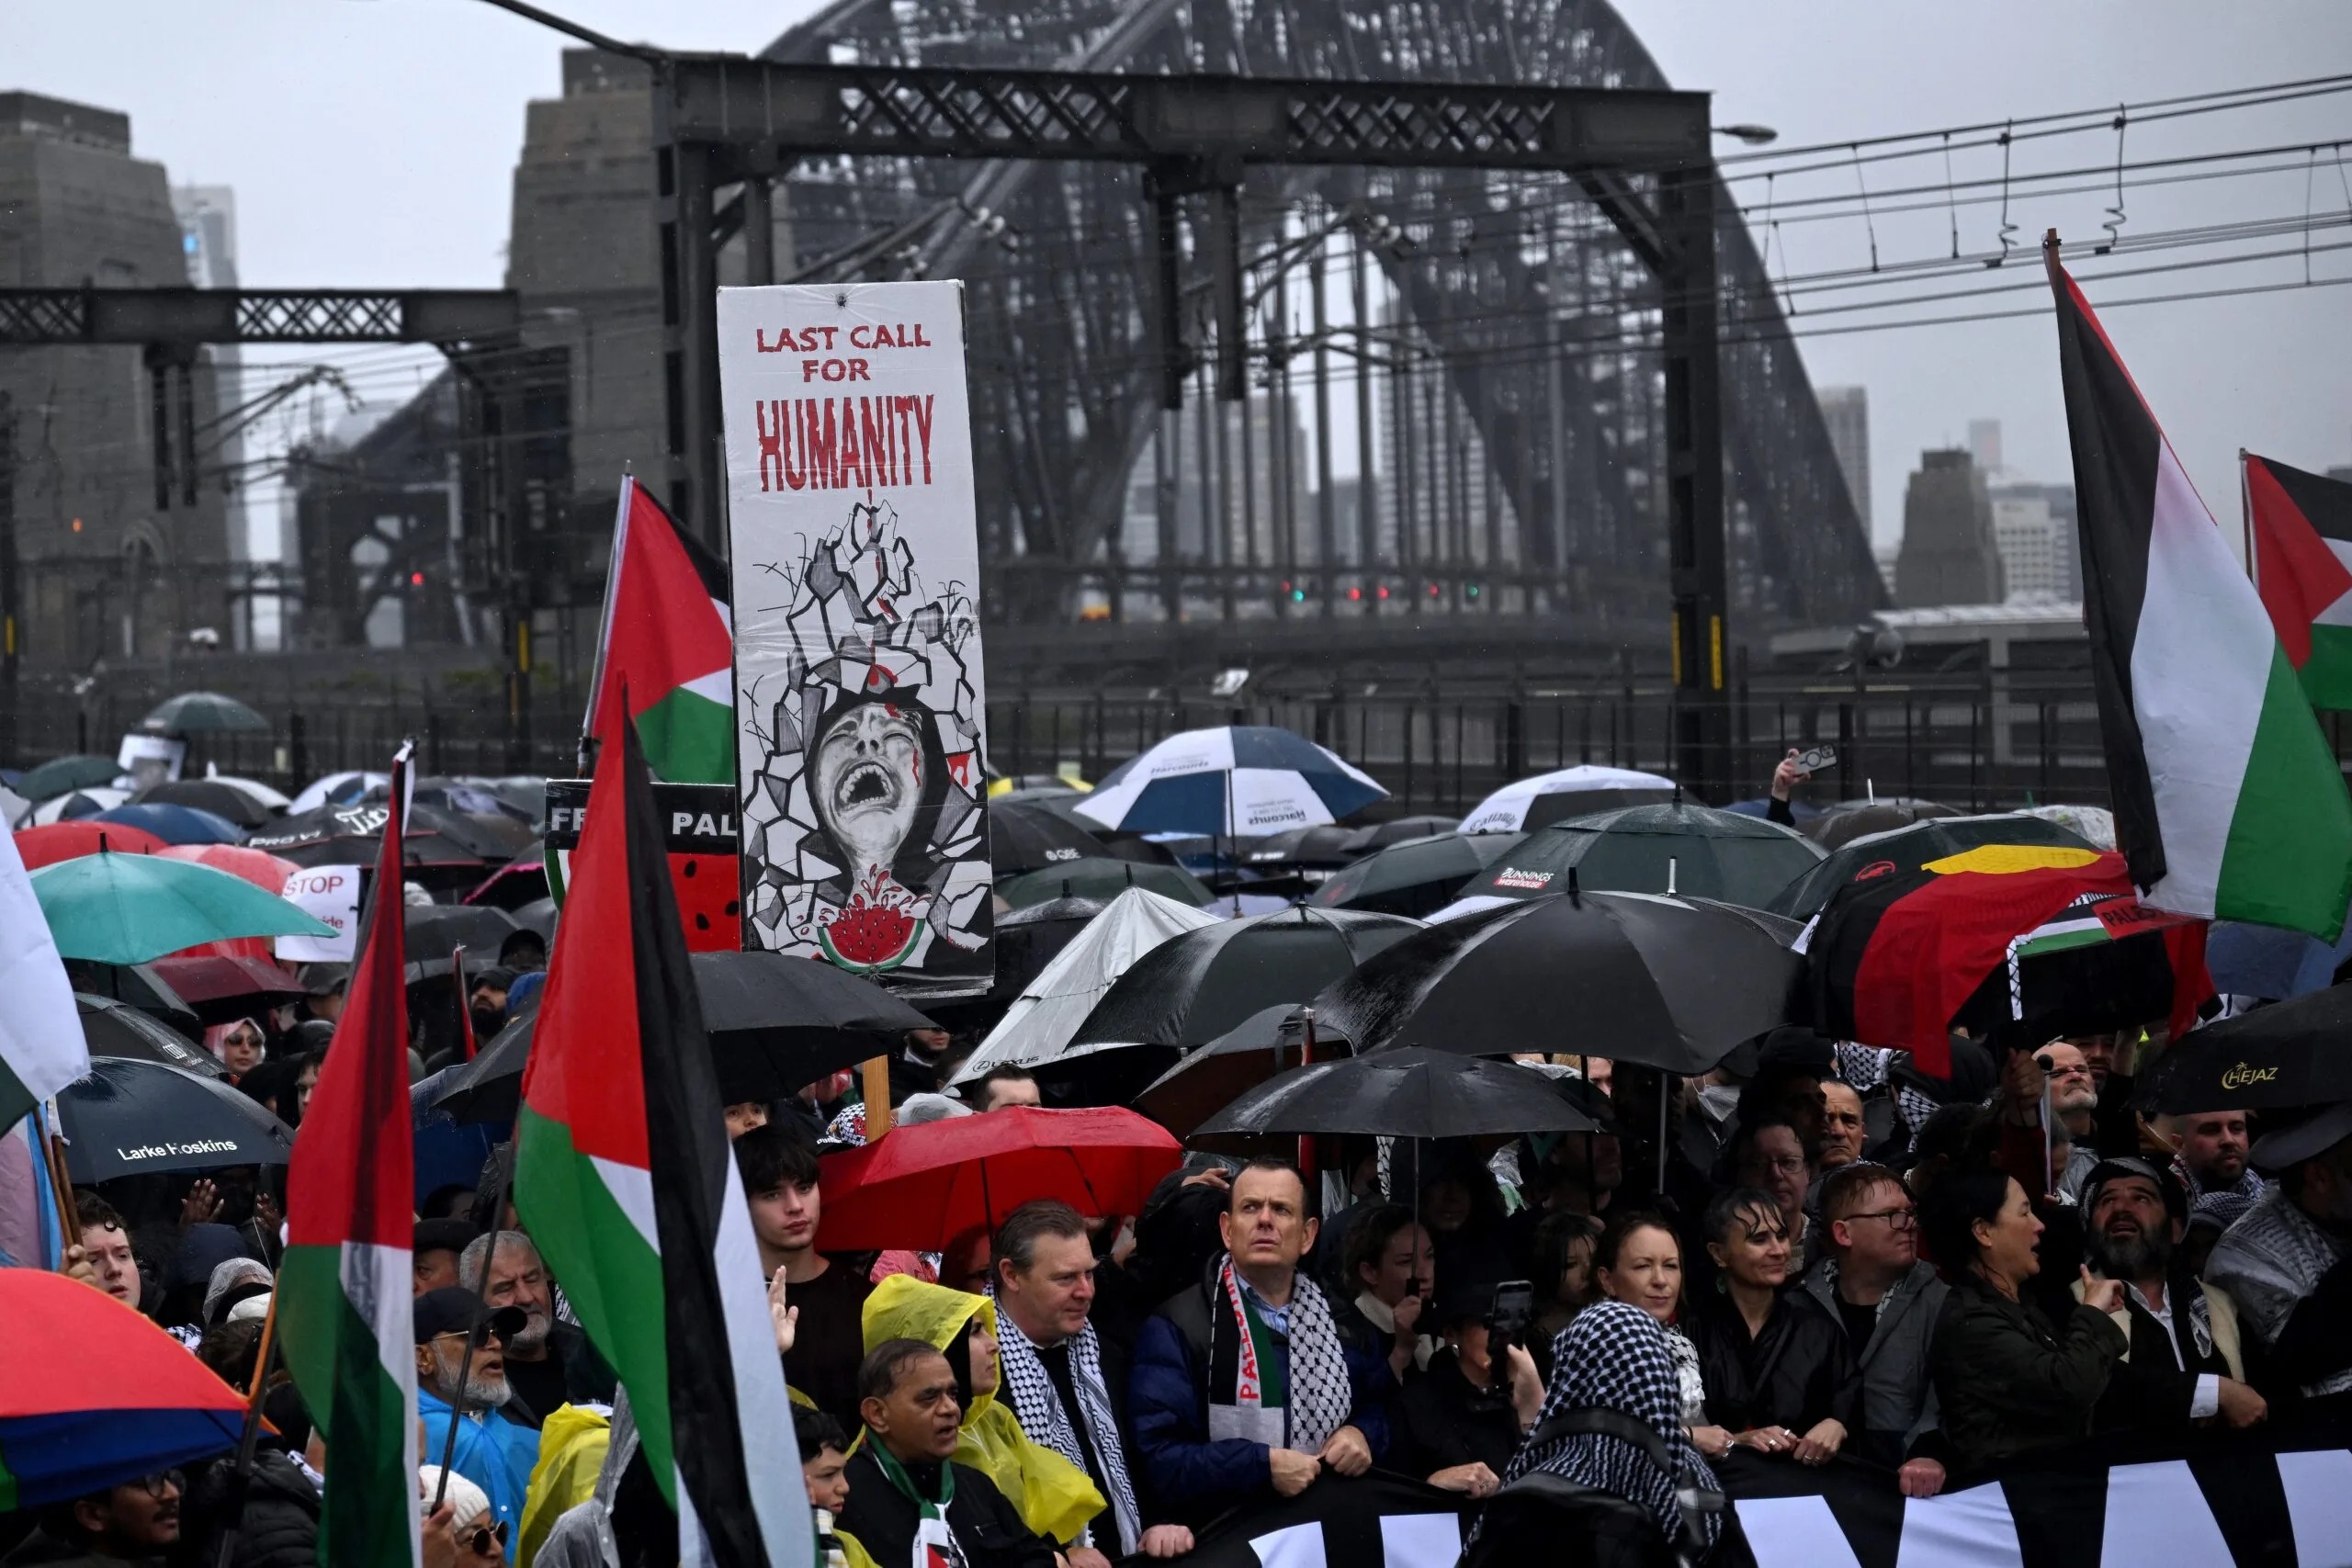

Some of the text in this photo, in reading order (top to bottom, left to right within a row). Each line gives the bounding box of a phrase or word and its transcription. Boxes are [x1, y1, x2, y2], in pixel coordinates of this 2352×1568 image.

[756, 323, 932, 353] LAST CALL
[802, 358, 871, 382] FOR
[756, 394, 934, 492] HUMANITY
[672, 812, 738, 837] PAL
[284, 875, 344, 897] STOP
[2227, 1066, 2278, 1086] HEJAZ
[118, 1145, 167, 1161] Larke
